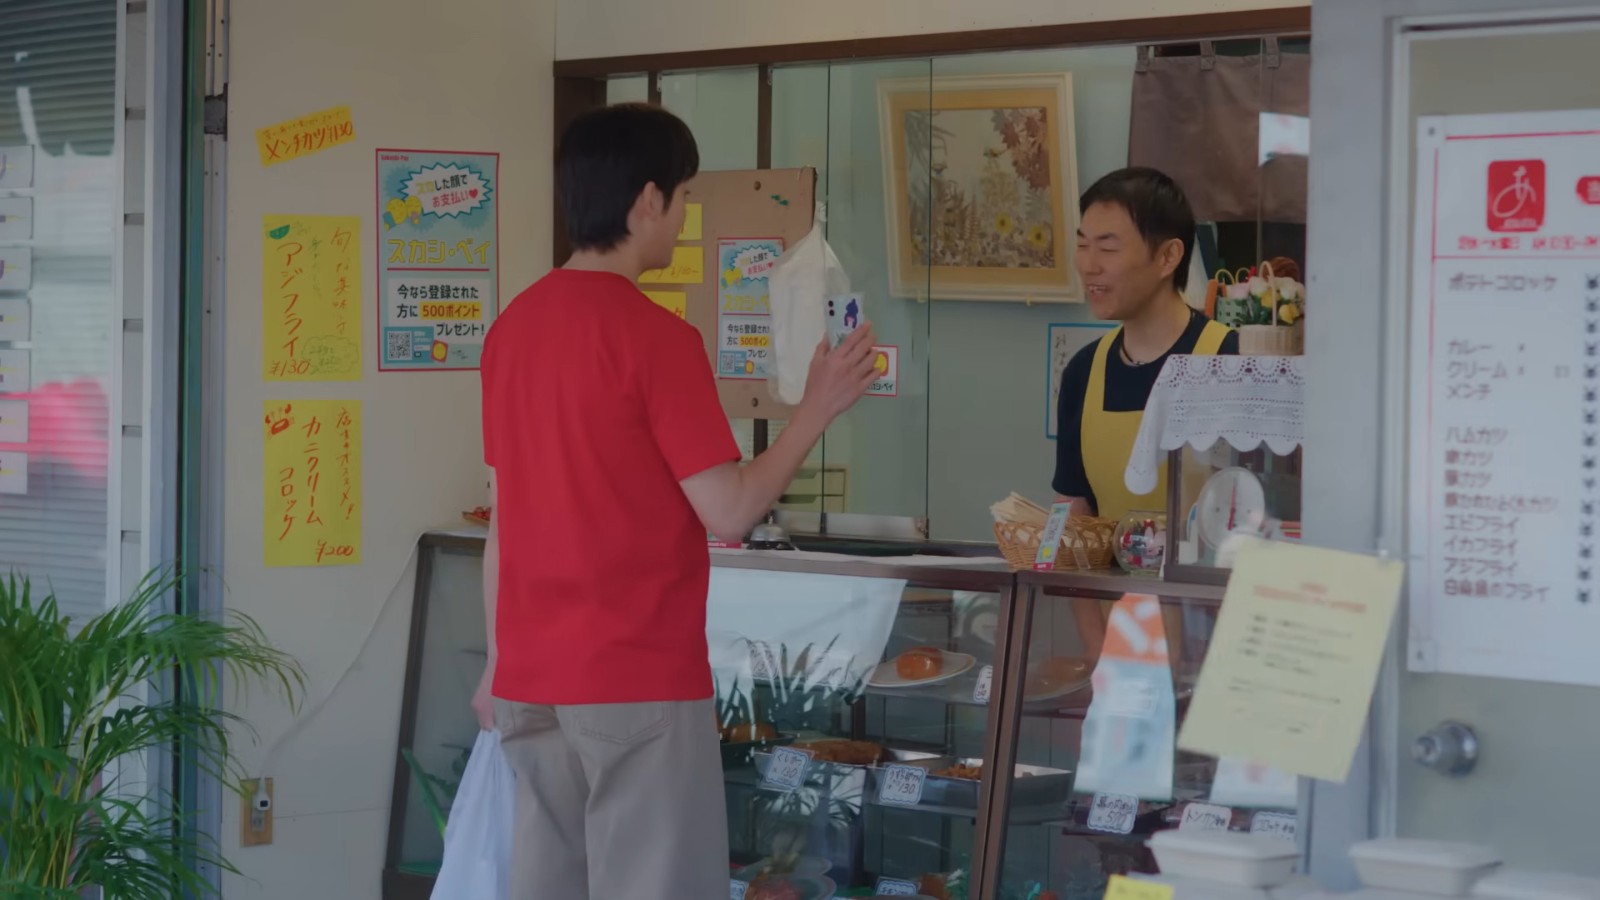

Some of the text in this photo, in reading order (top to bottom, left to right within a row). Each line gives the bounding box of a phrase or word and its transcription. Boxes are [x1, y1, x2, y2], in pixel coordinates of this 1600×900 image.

[415, 174, 468, 194] スカした顔で
[432, 190, 469, 208] お支払い
[387, 238, 491, 264] スカシ・ペイ
[276, 241, 303, 358] アジフライ
[397, 283, 479, 299] 今なら登録された
[396, 303, 480, 318] 方に 500ポイント
[436, 322, 485, 337] プレゼント!
[727, 323, 770, 334] 今なら登録され
[301, 416, 323, 526] カニクリーム
[279, 466, 297, 541] コロッケ
[1444, 514, 1520, 534] エビフライ
[315, 538, 354, 563] ¥200
[1444, 535, 1519, 556] イカフライ
